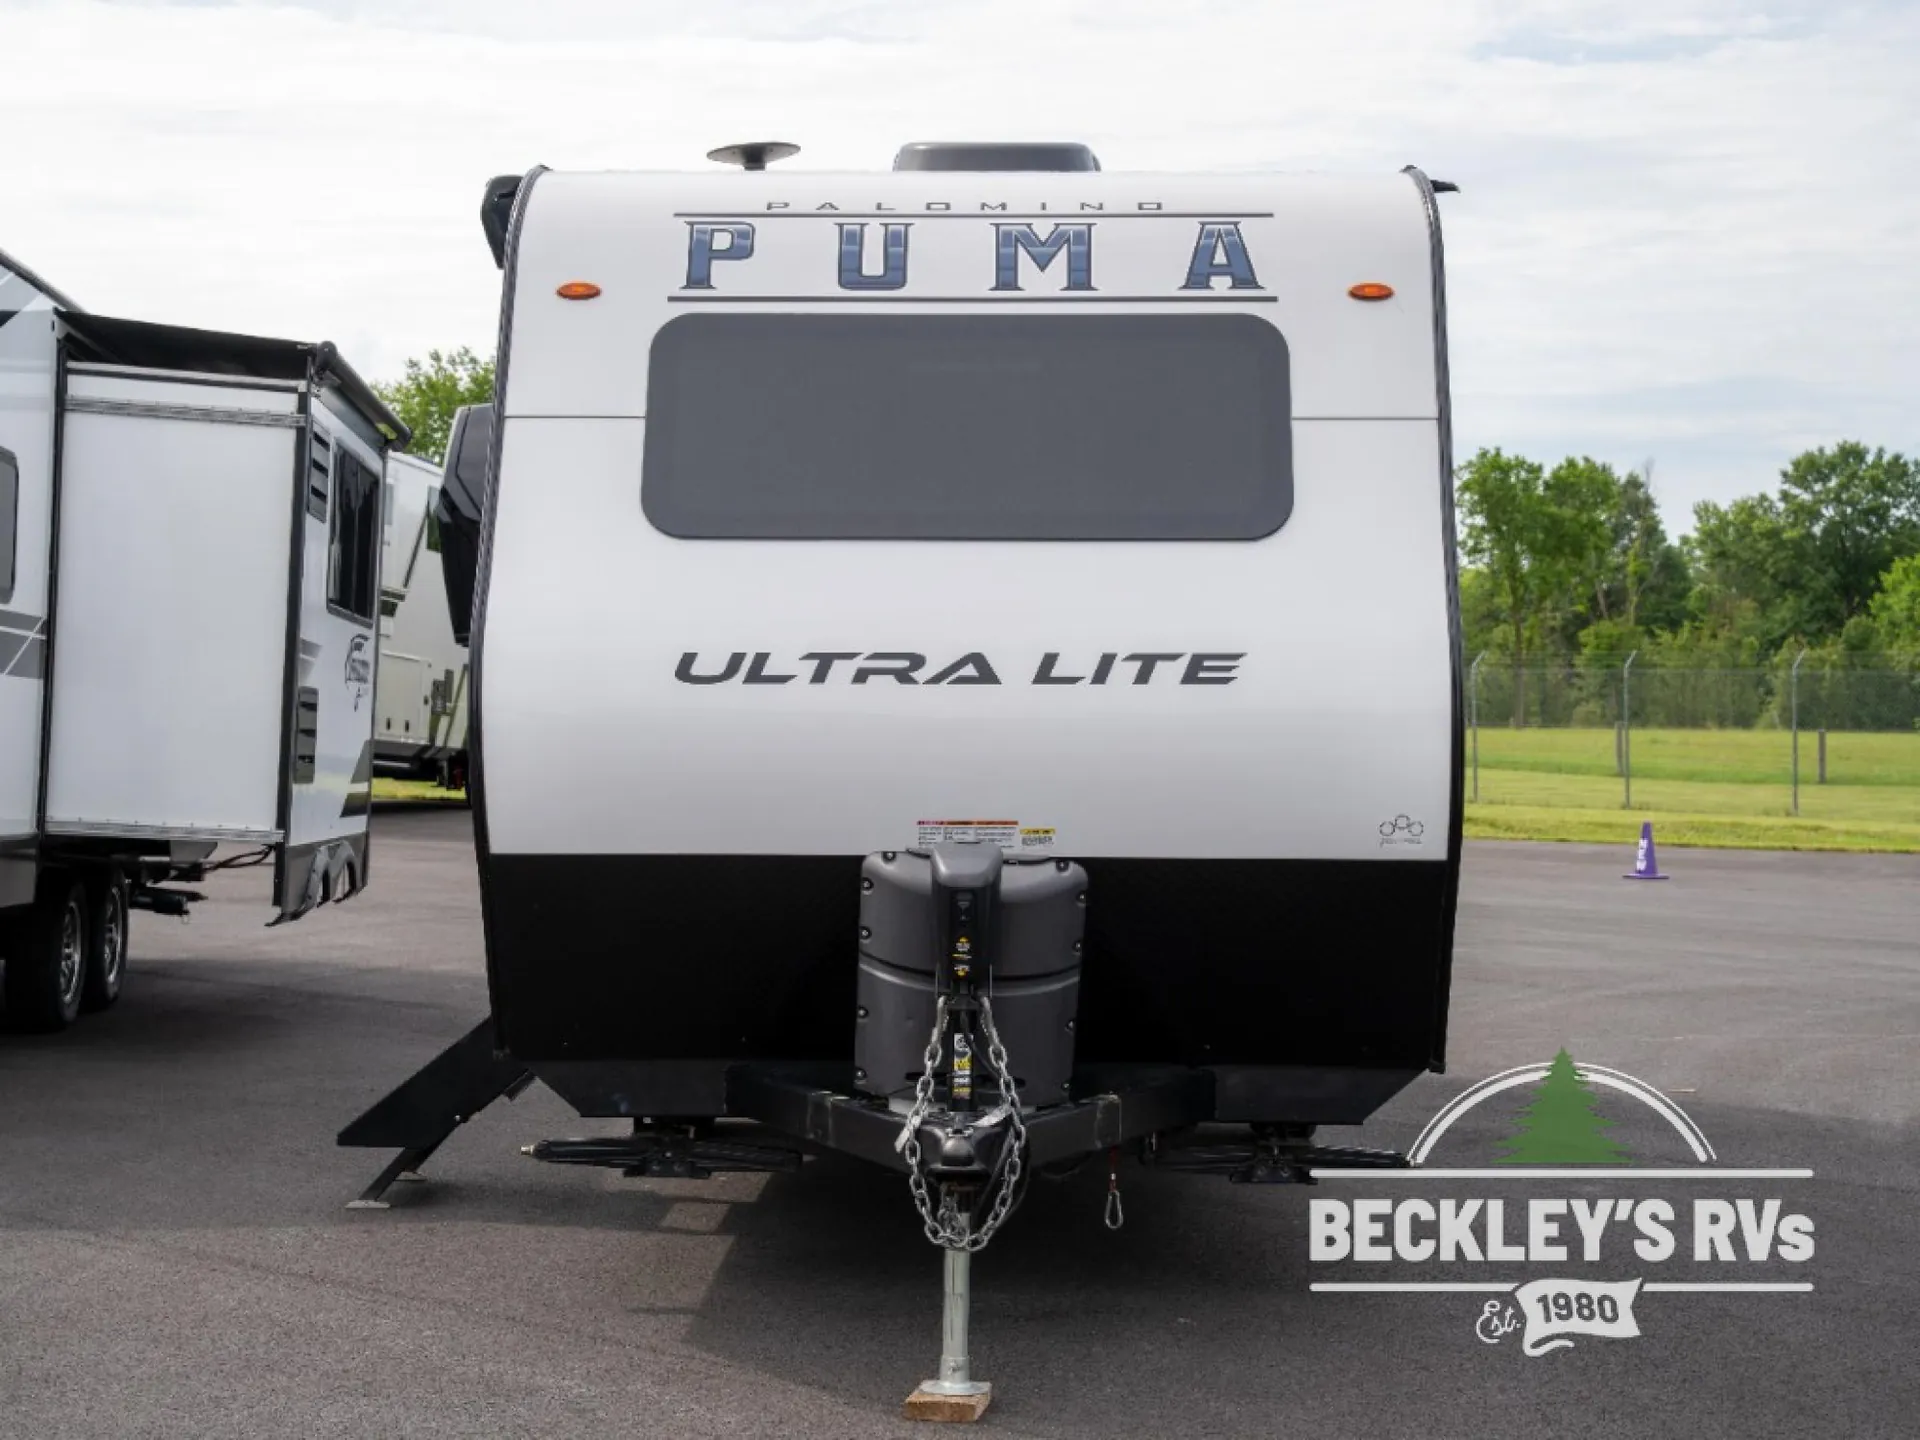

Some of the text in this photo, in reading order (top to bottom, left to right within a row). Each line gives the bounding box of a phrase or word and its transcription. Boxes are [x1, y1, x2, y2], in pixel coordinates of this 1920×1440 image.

[766, 201, 1163, 211] PALOMINO
[680, 221, 1266, 291] PUMA
[674, 652, 1247, 685] ULTRA LITE
